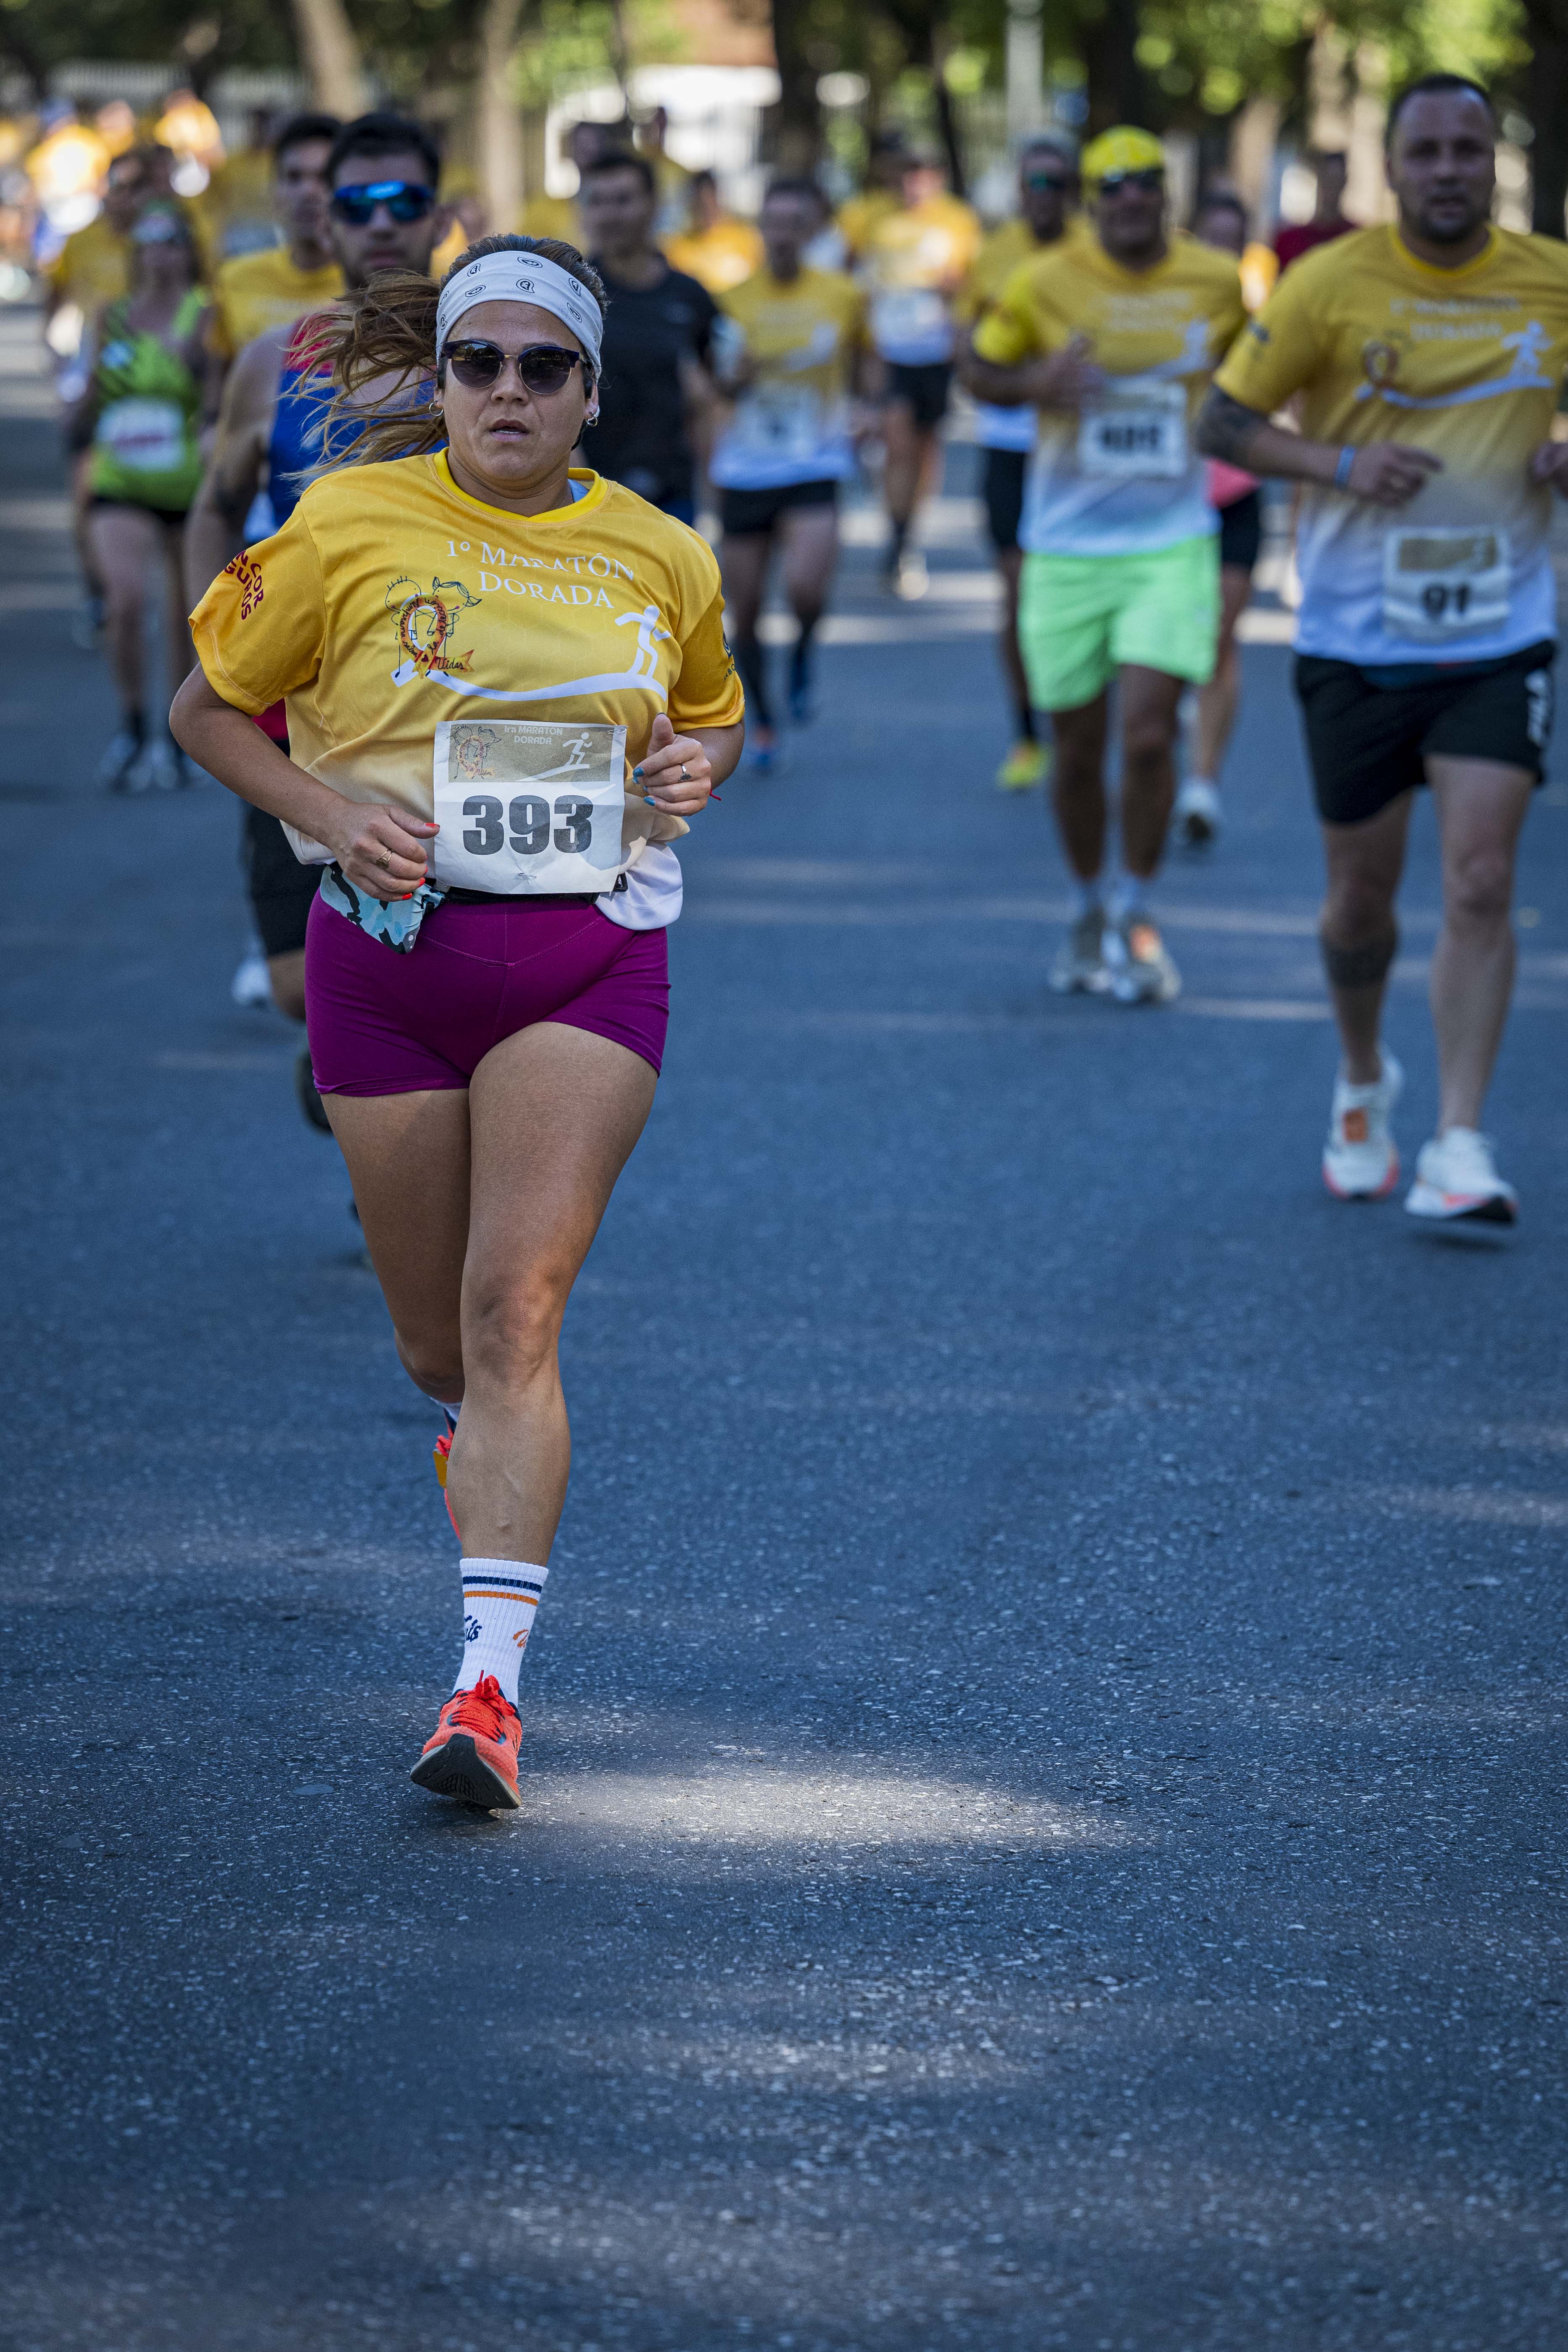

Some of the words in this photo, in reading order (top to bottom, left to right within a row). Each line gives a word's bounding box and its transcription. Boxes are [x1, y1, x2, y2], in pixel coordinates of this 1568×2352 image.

[480, 542, 634, 581] MARATÓN
[478, 571, 615, 608] DORADA
[514, 735, 552, 745] DORADA
[463, 795, 593, 855] 393
